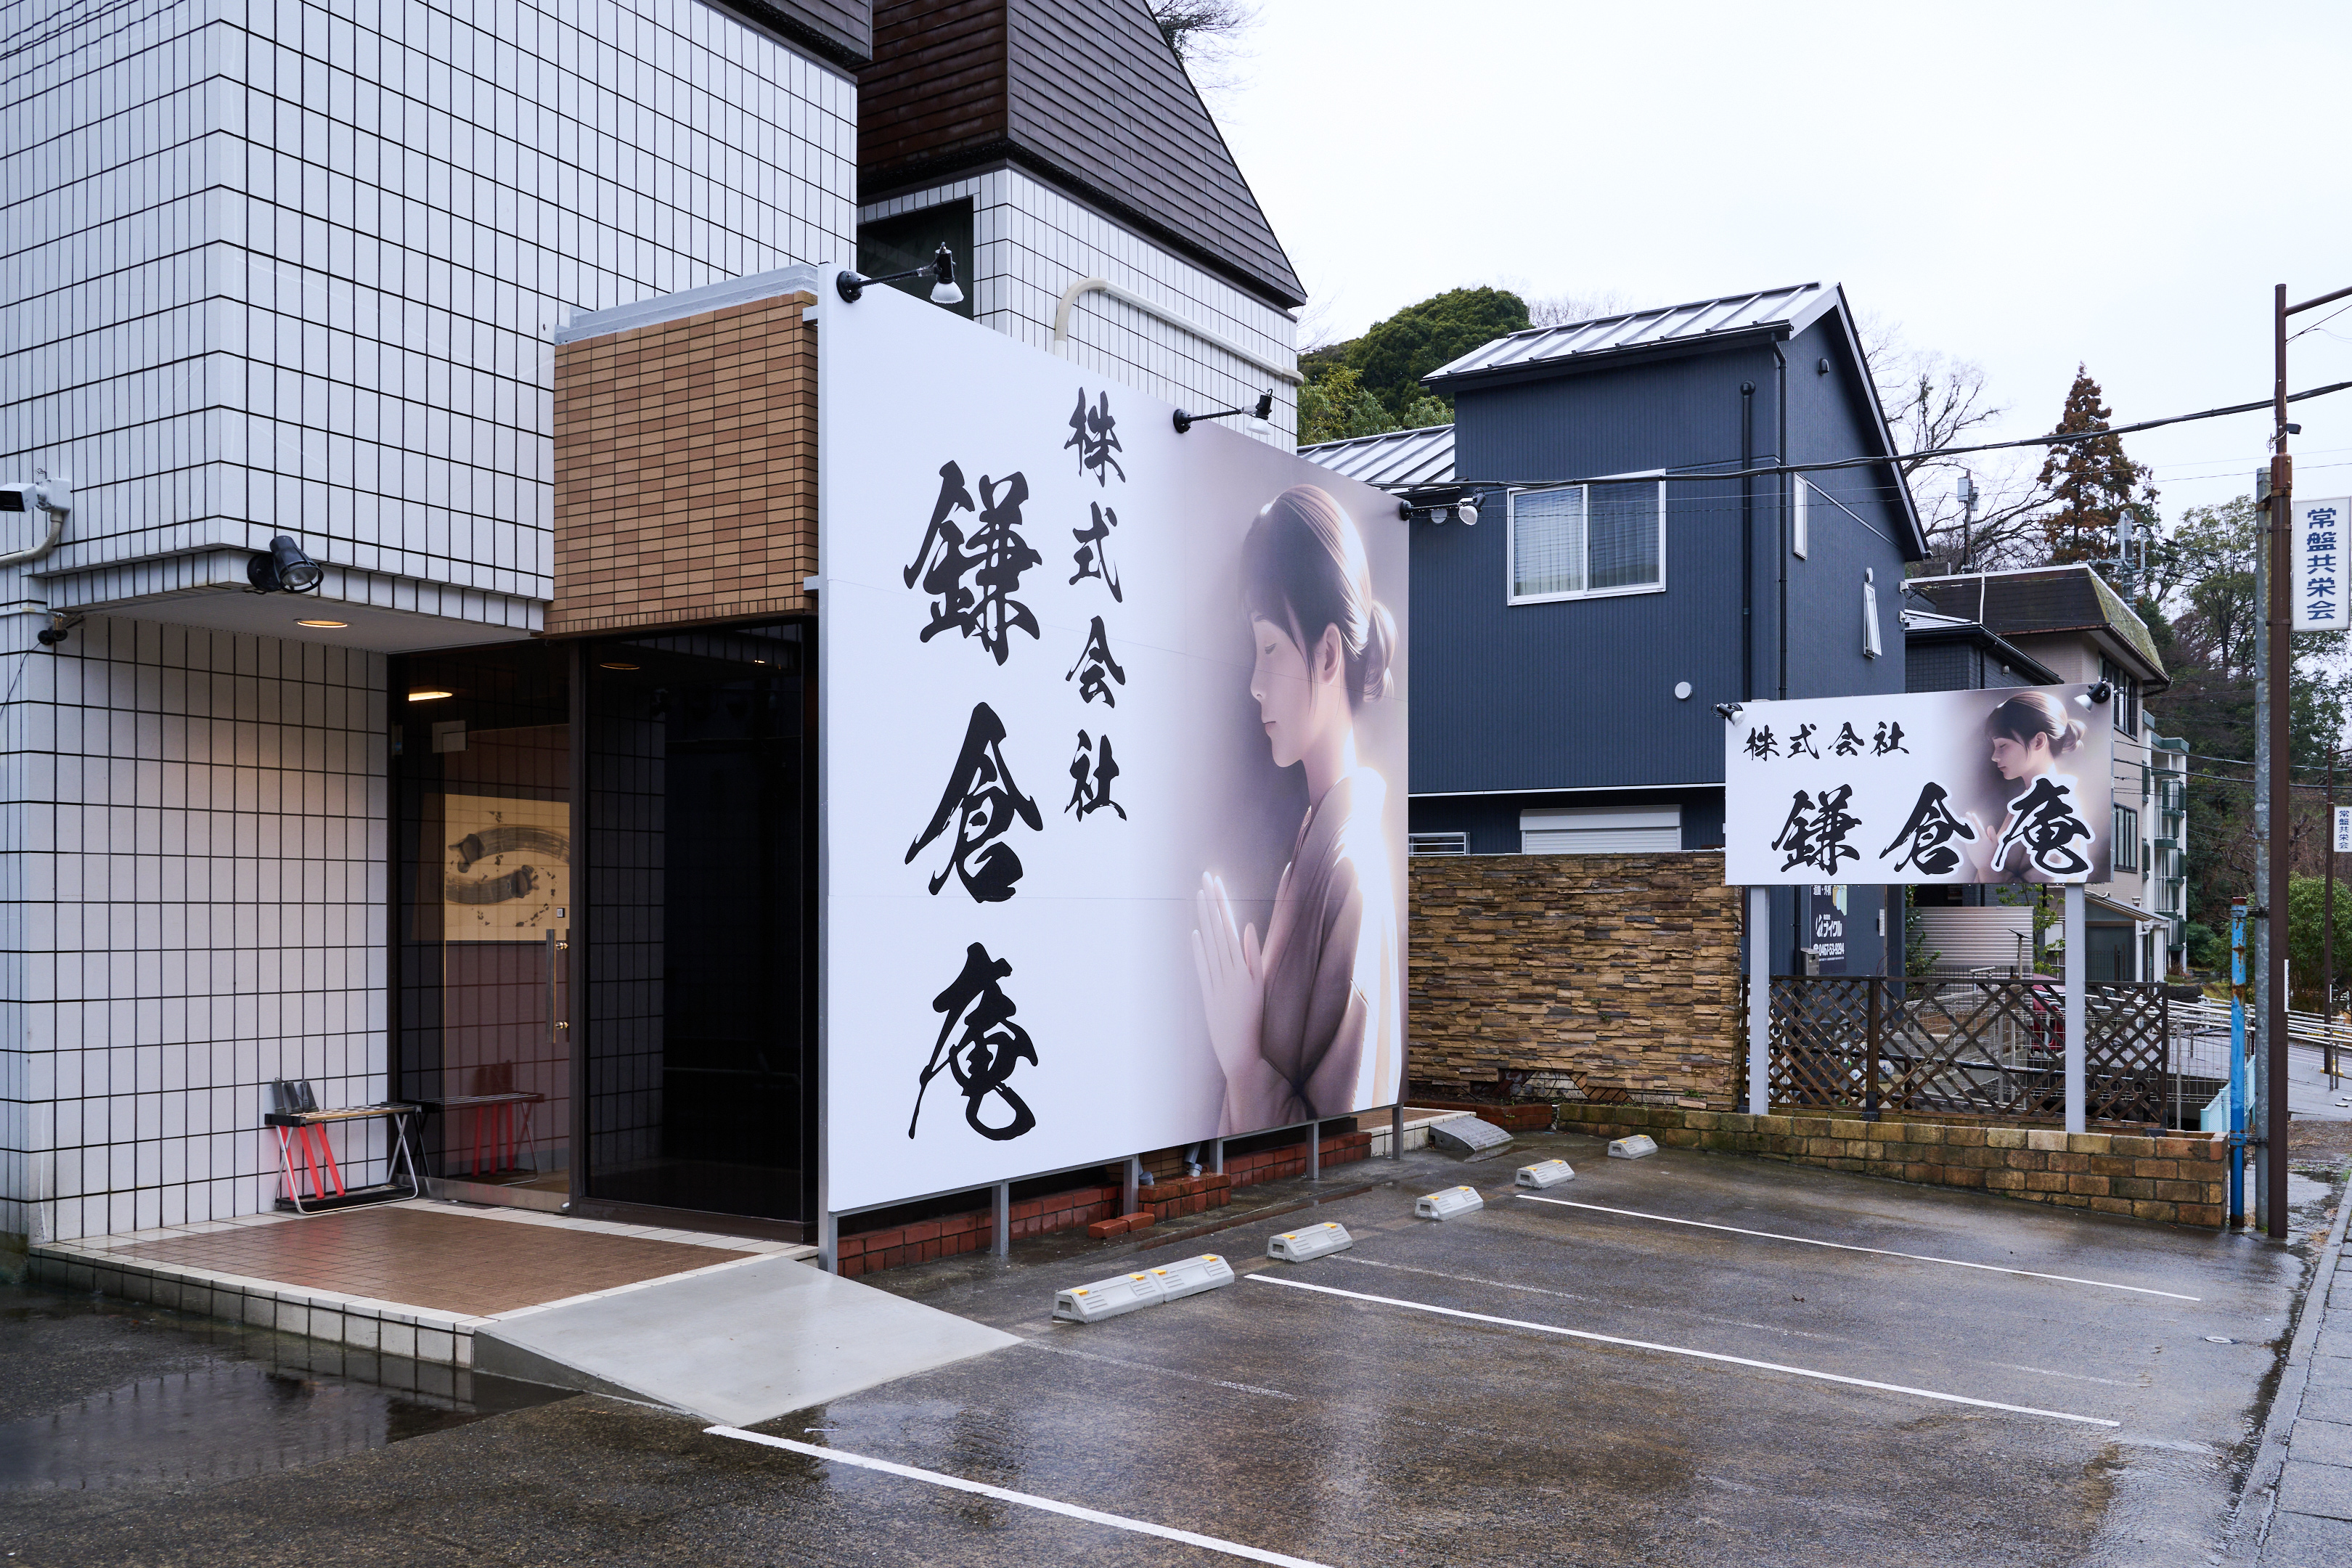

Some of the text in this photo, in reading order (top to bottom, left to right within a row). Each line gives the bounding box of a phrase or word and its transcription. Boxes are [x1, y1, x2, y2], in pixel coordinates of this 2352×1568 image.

[1063, 386, 1127, 822] 株式会社
[2307, 507, 2337, 621] 常盤共栄会
[1744, 721, 1910, 762] 株式会社
[904, 460, 1043, 1141] 鎌倉庵
[1771, 777, 2092, 876] 鎌倉庵
[2338, 810, 2350, 849] 常盤共栄会
